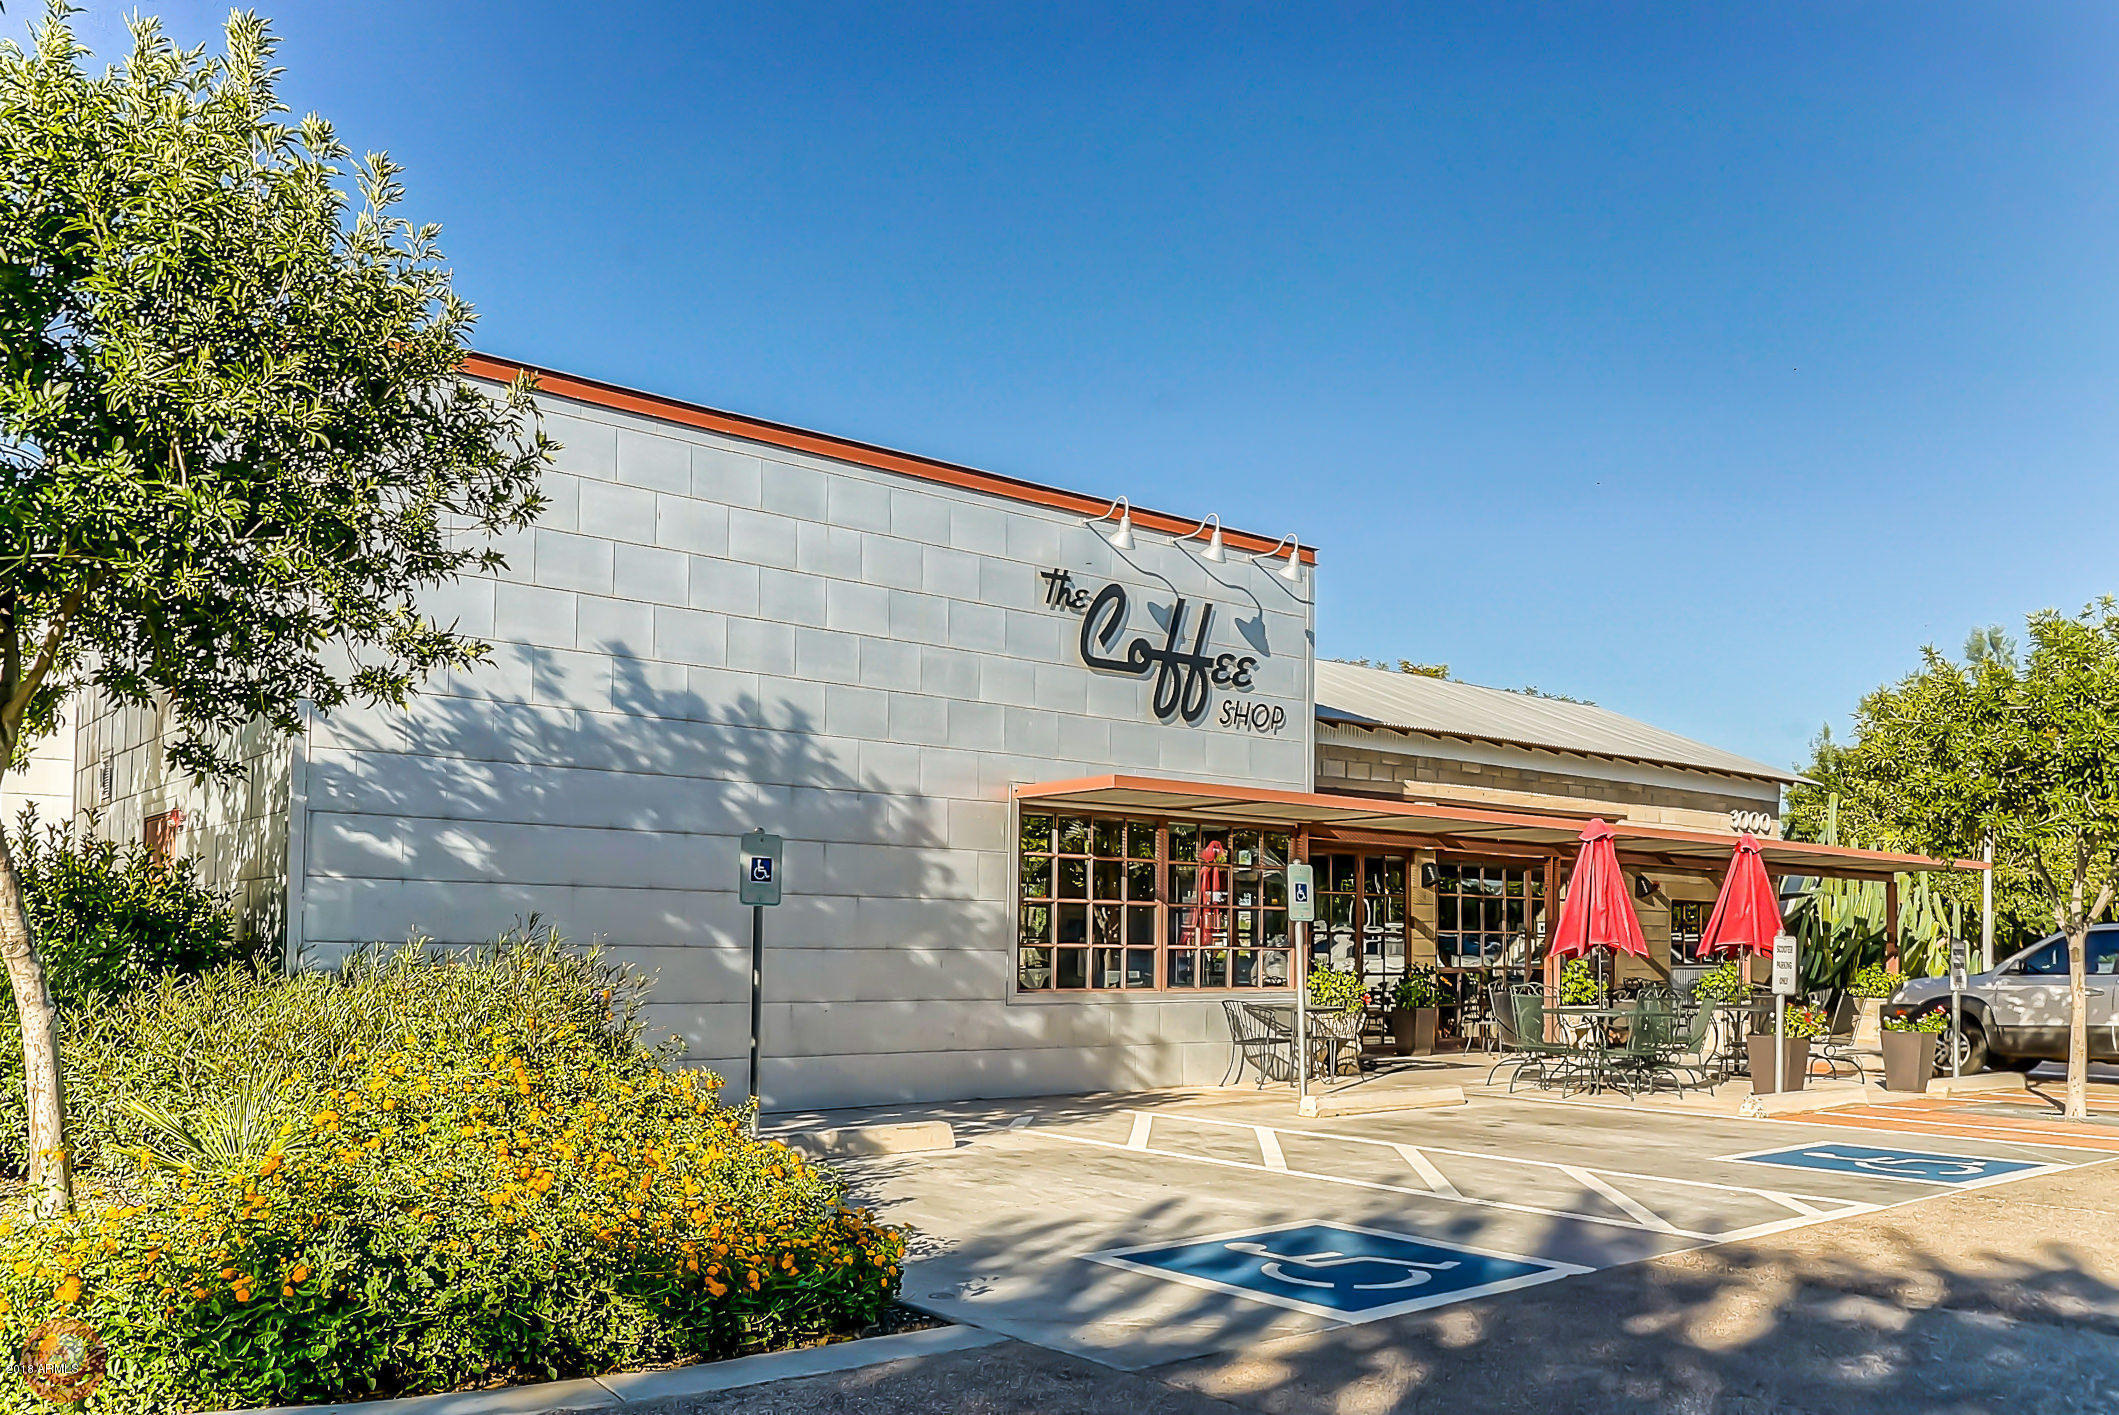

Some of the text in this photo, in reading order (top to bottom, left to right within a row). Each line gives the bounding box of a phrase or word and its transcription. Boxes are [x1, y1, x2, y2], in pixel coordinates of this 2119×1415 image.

[1040, 568, 1089, 608] The
[1080, 583, 1257, 722] Coffee
[1219, 700, 1285, 730] SHOP
[1729, 809, 1771, 832] 3000
[1776, 961, 1793, 970] PARKING
